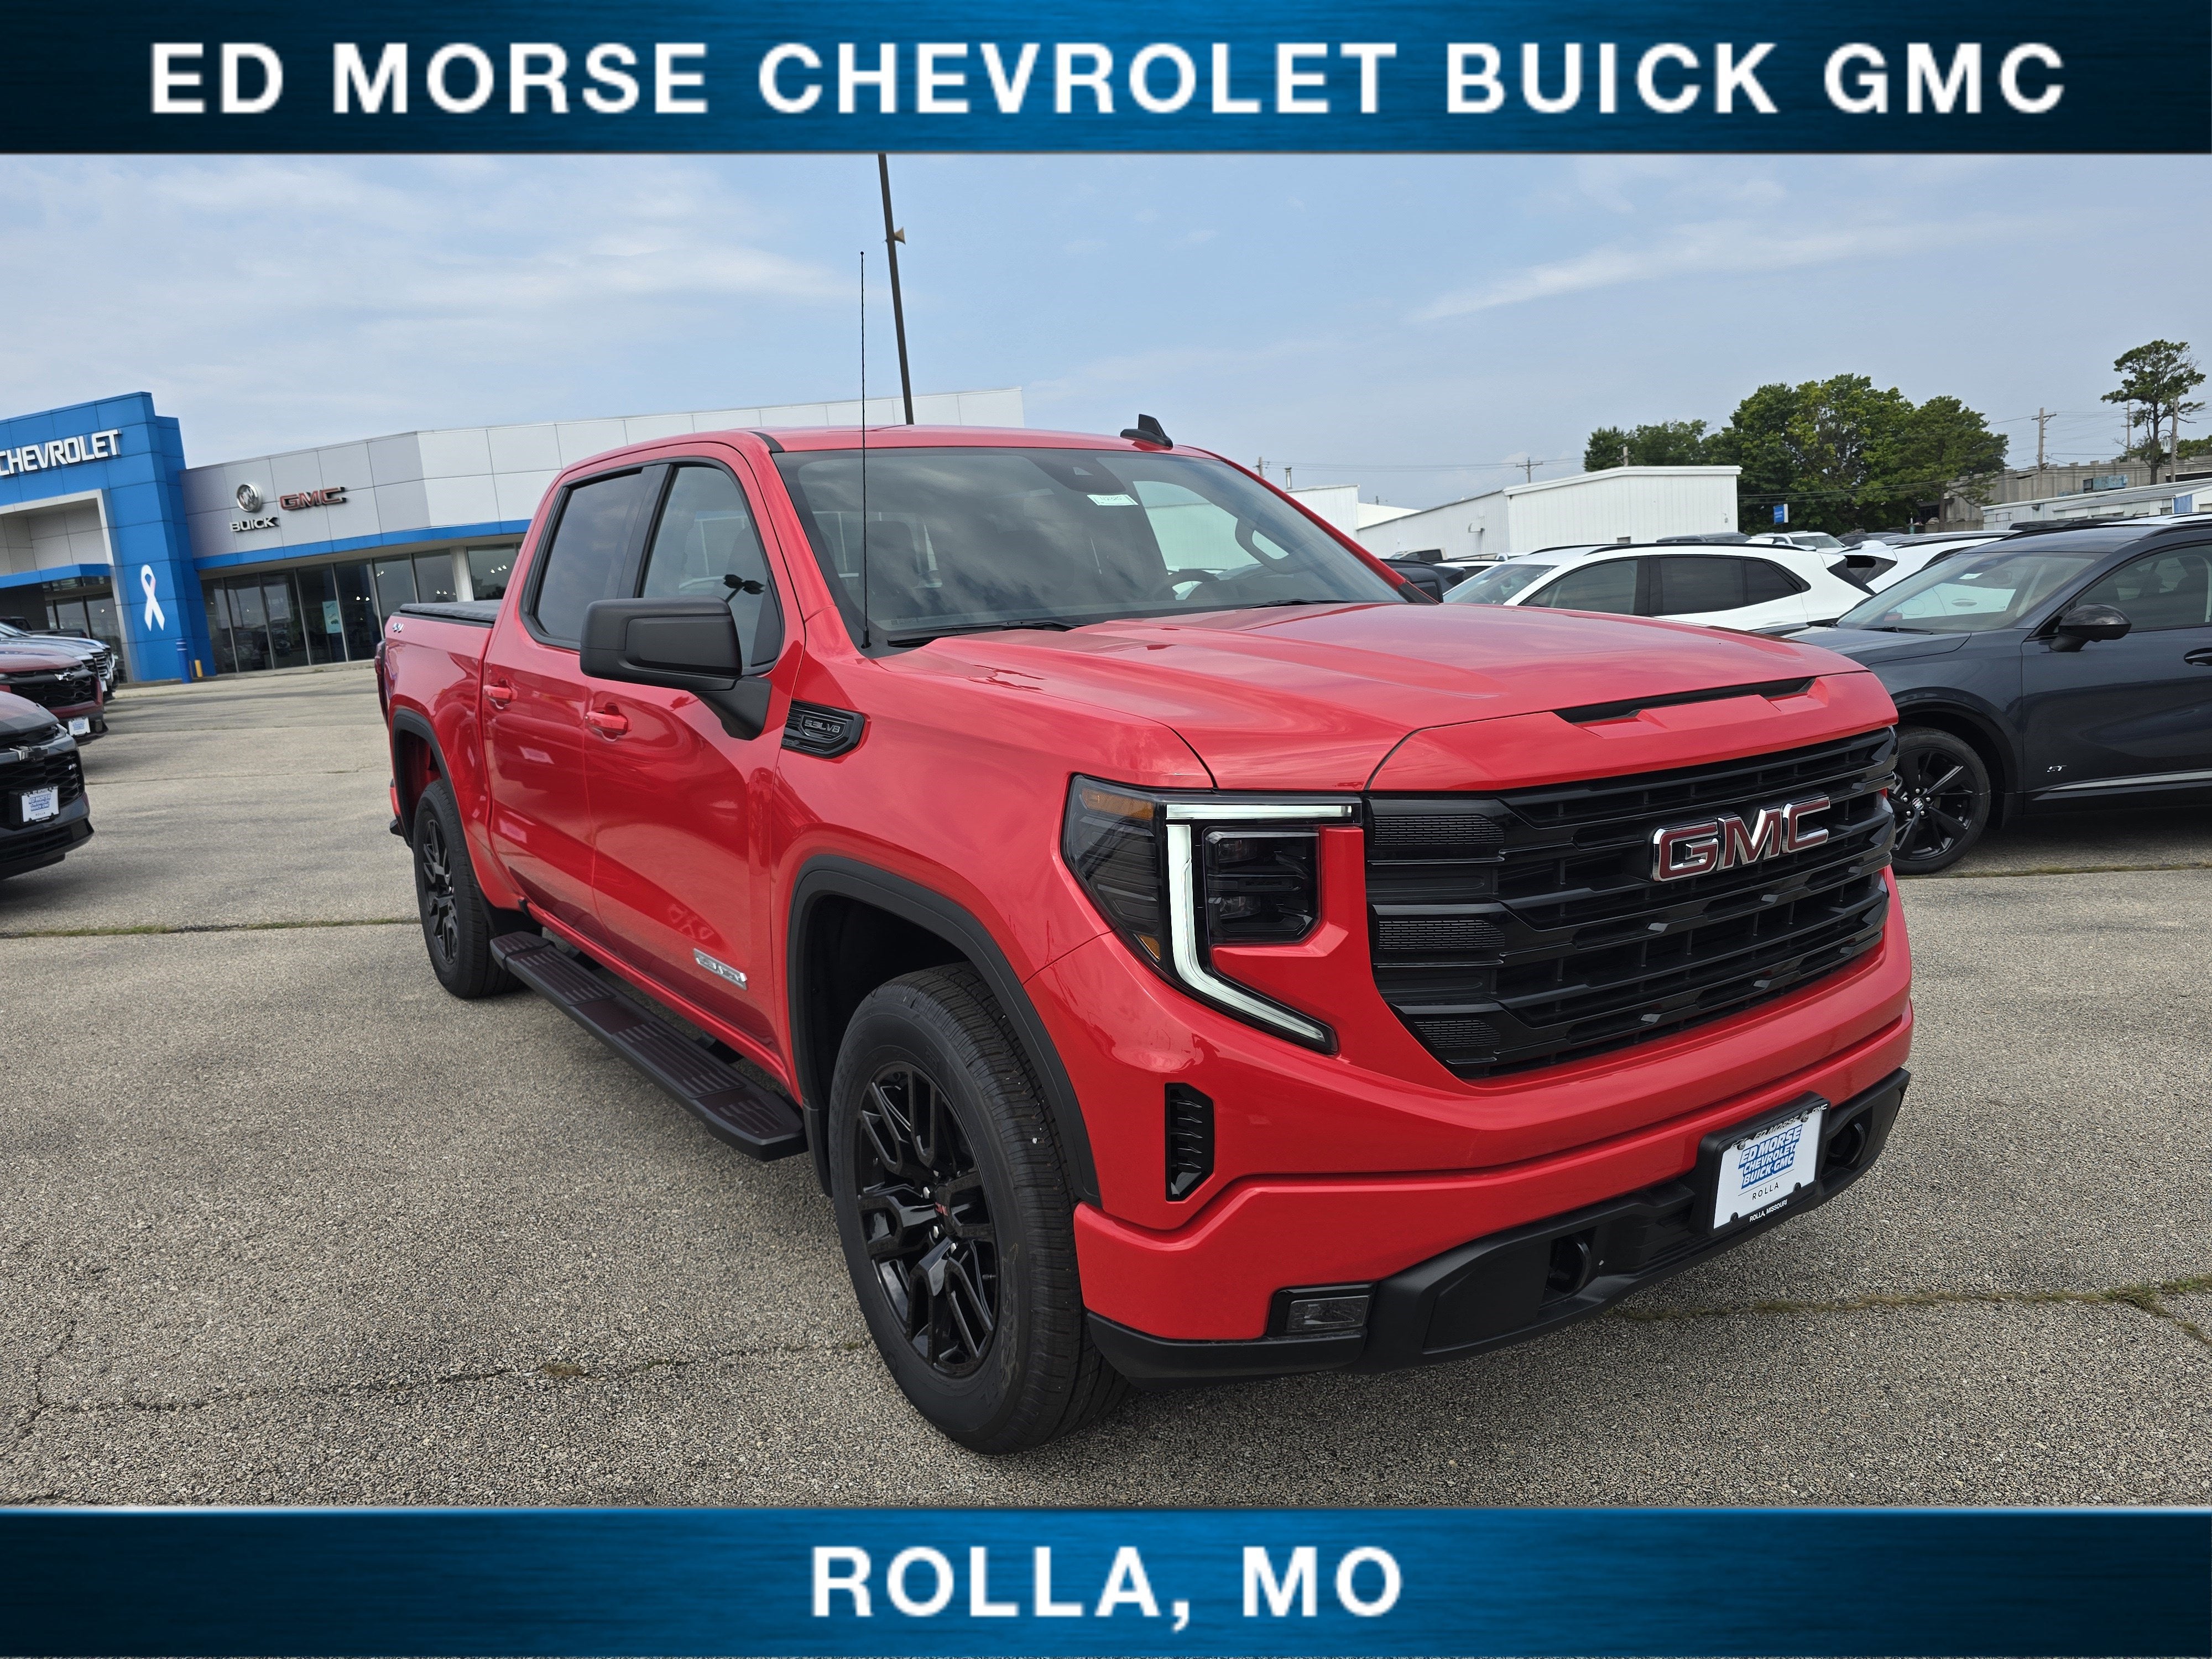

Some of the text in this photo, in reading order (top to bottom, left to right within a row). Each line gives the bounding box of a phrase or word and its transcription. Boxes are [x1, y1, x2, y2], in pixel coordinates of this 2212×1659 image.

[0, 429, 121, 476] CHEVROLET
[280, 487, 345, 510] GMC
[229, 515, 277, 533] BUICK
[1652, 796, 1830, 881] GMC
[1739, 1125, 1802, 1165] ED MORSE
[1752, 1182, 1779, 1201] ROLLA
[1766, 1199, 1788, 1214] MISSOURI
